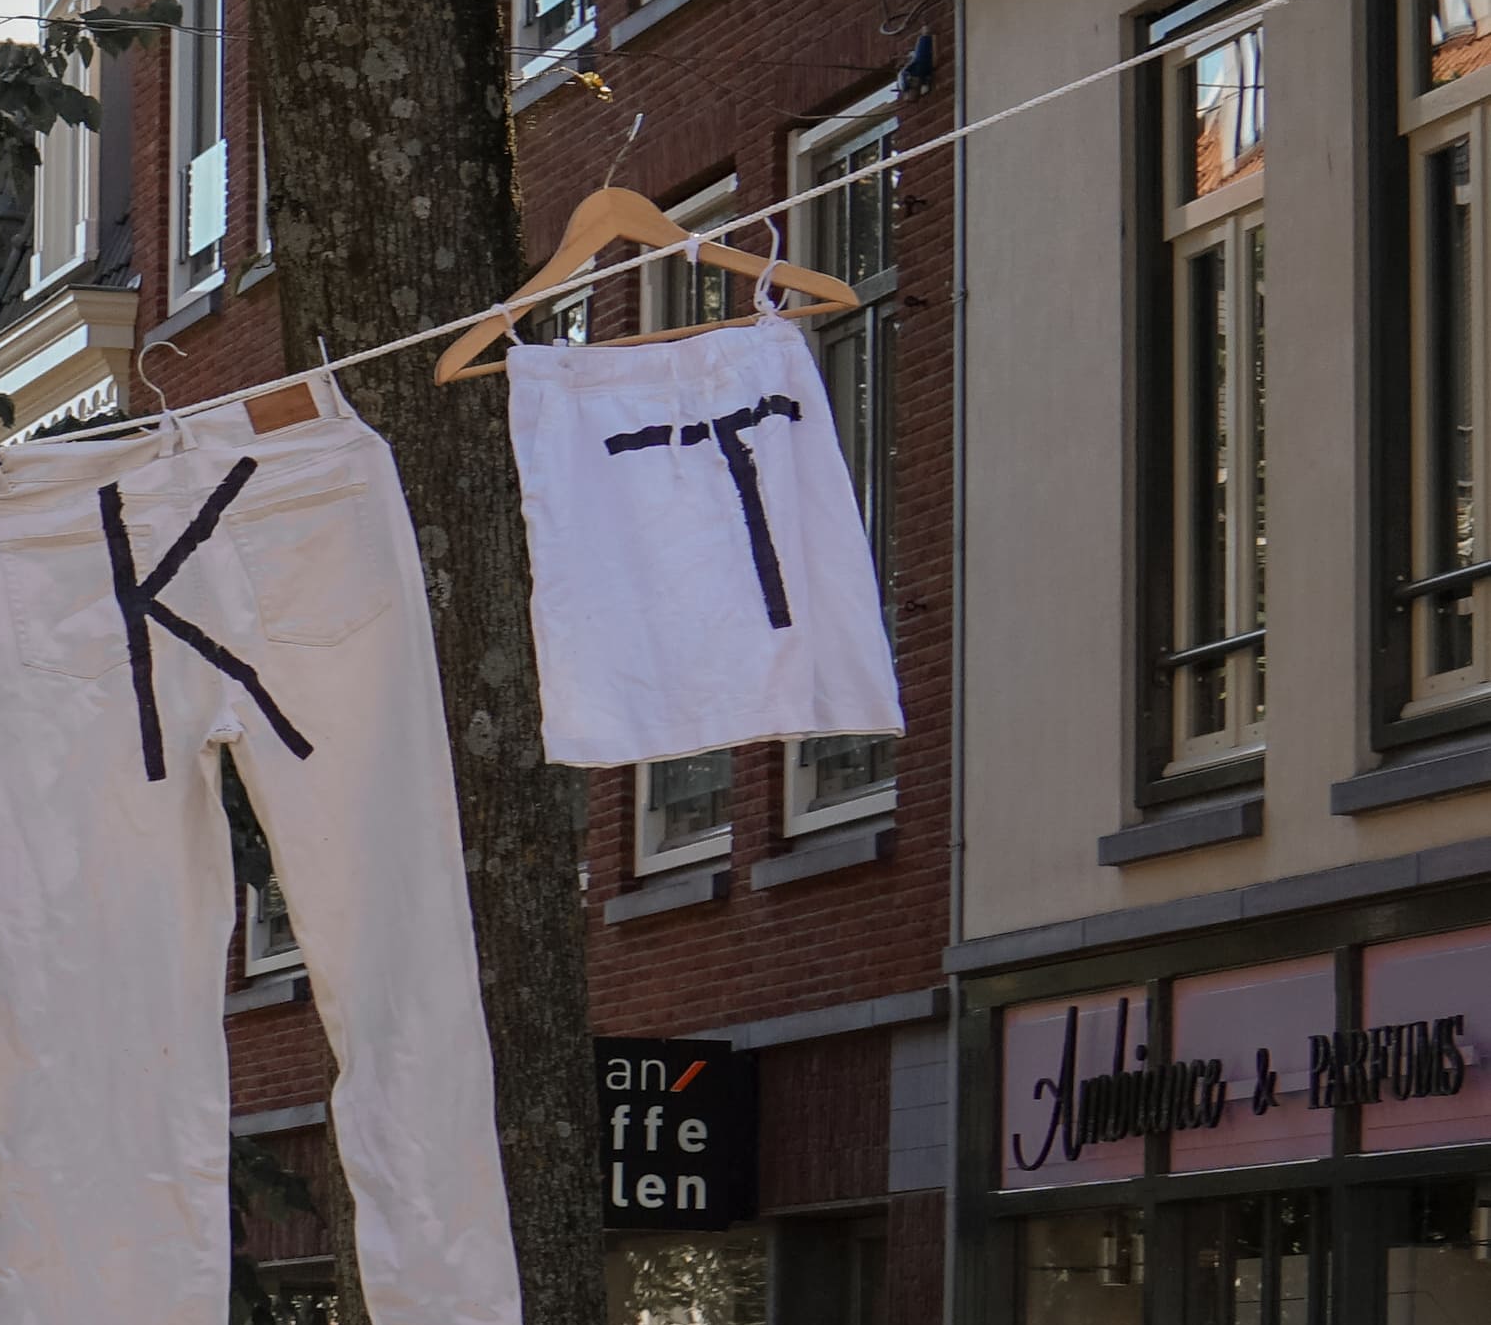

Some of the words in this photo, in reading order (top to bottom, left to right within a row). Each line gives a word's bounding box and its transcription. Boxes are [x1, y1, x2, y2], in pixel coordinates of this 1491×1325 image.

[1012, 997, 1227, 1172] Ambiance
[1252, 1048, 1280, 1116] &
[1306, 1013, 1465, 1110] PARFUMS
